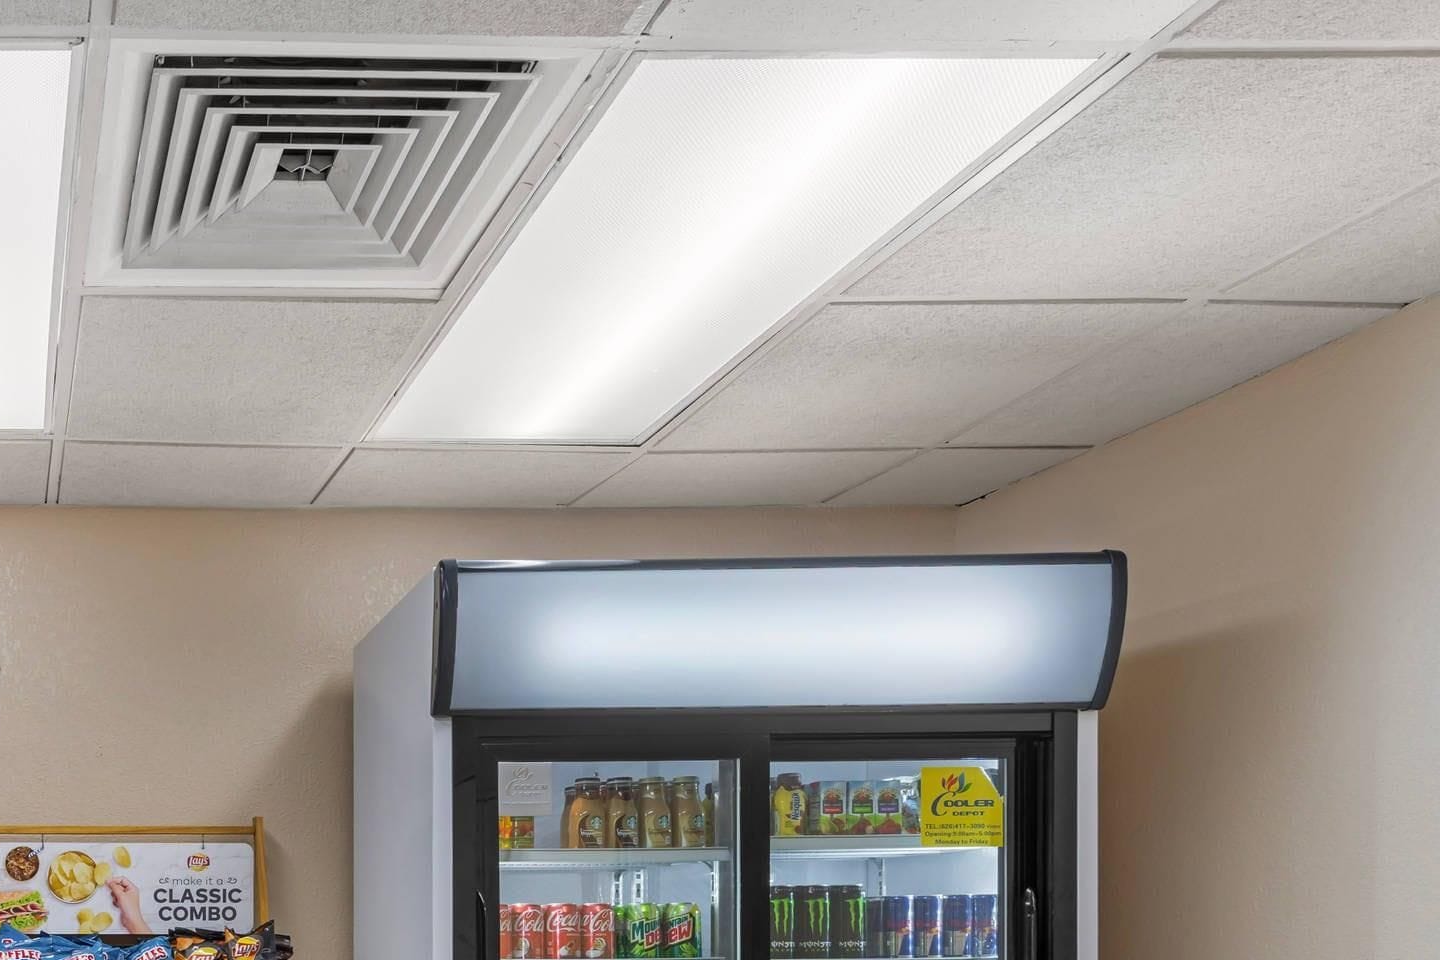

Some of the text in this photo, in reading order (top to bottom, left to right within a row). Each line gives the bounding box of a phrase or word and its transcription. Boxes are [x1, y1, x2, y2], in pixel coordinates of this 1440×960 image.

[931, 791, 995, 816] COOLER
[188, 855, 210, 868] Lay's
[172, 877, 203, 886] make
[205, 877, 213, 886] it
[153, 888, 242, 904] CLASSIC
[158, 906, 237, 921] COMBO
